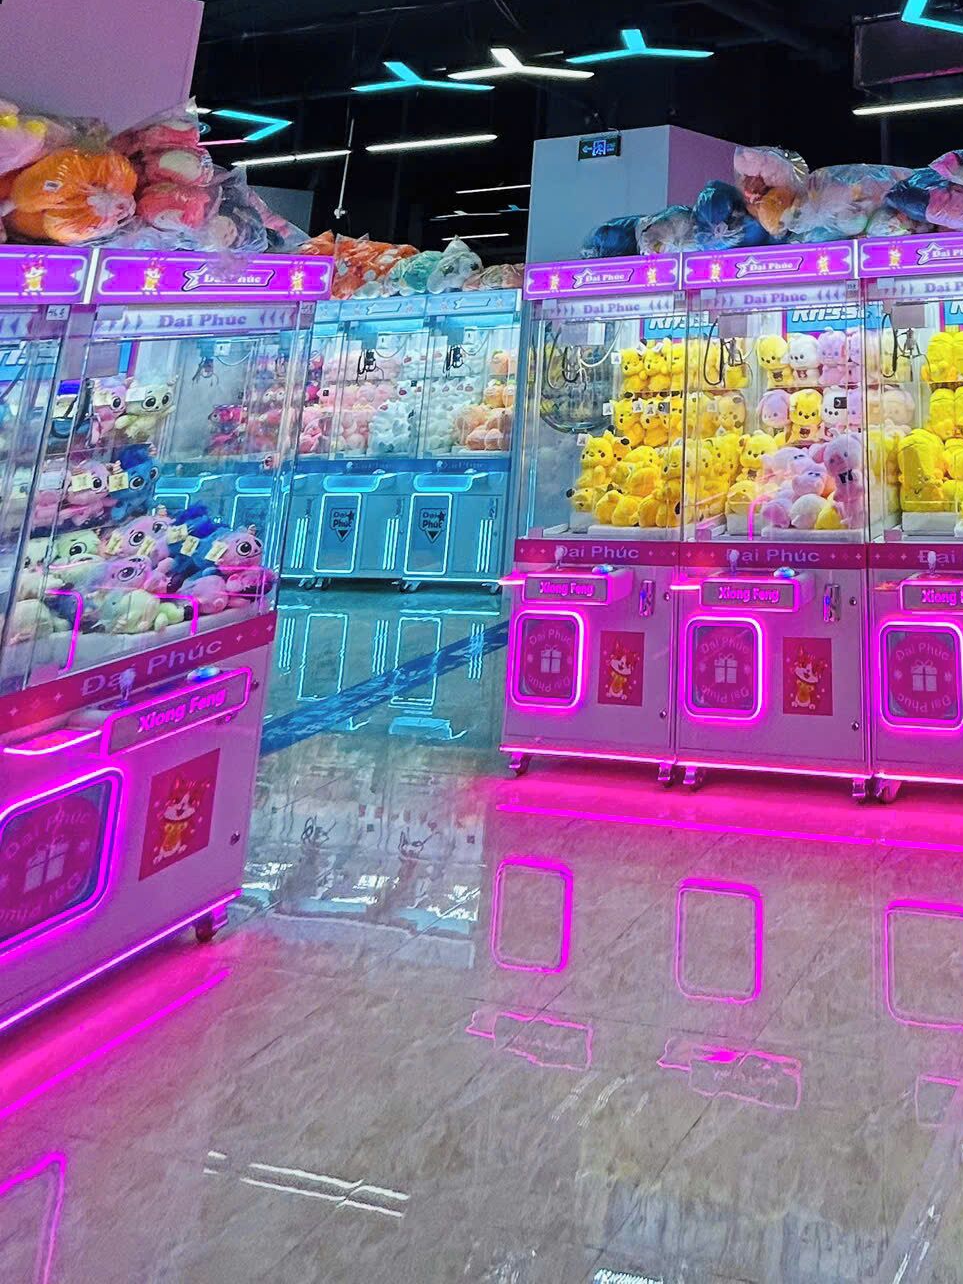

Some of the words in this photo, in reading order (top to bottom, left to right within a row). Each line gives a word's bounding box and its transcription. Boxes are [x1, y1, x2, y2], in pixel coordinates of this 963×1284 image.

[591, 545, 639, 559] Phúc
[766, 548, 820, 562] Phúc
[921, 588, 957, 606] Xiong
[81, 663, 136, 696] Đạ
[147, 640, 222, 675] Phúc
[138, 704, 187, 733] Xiong
[189, 689, 226, 714] Feng
